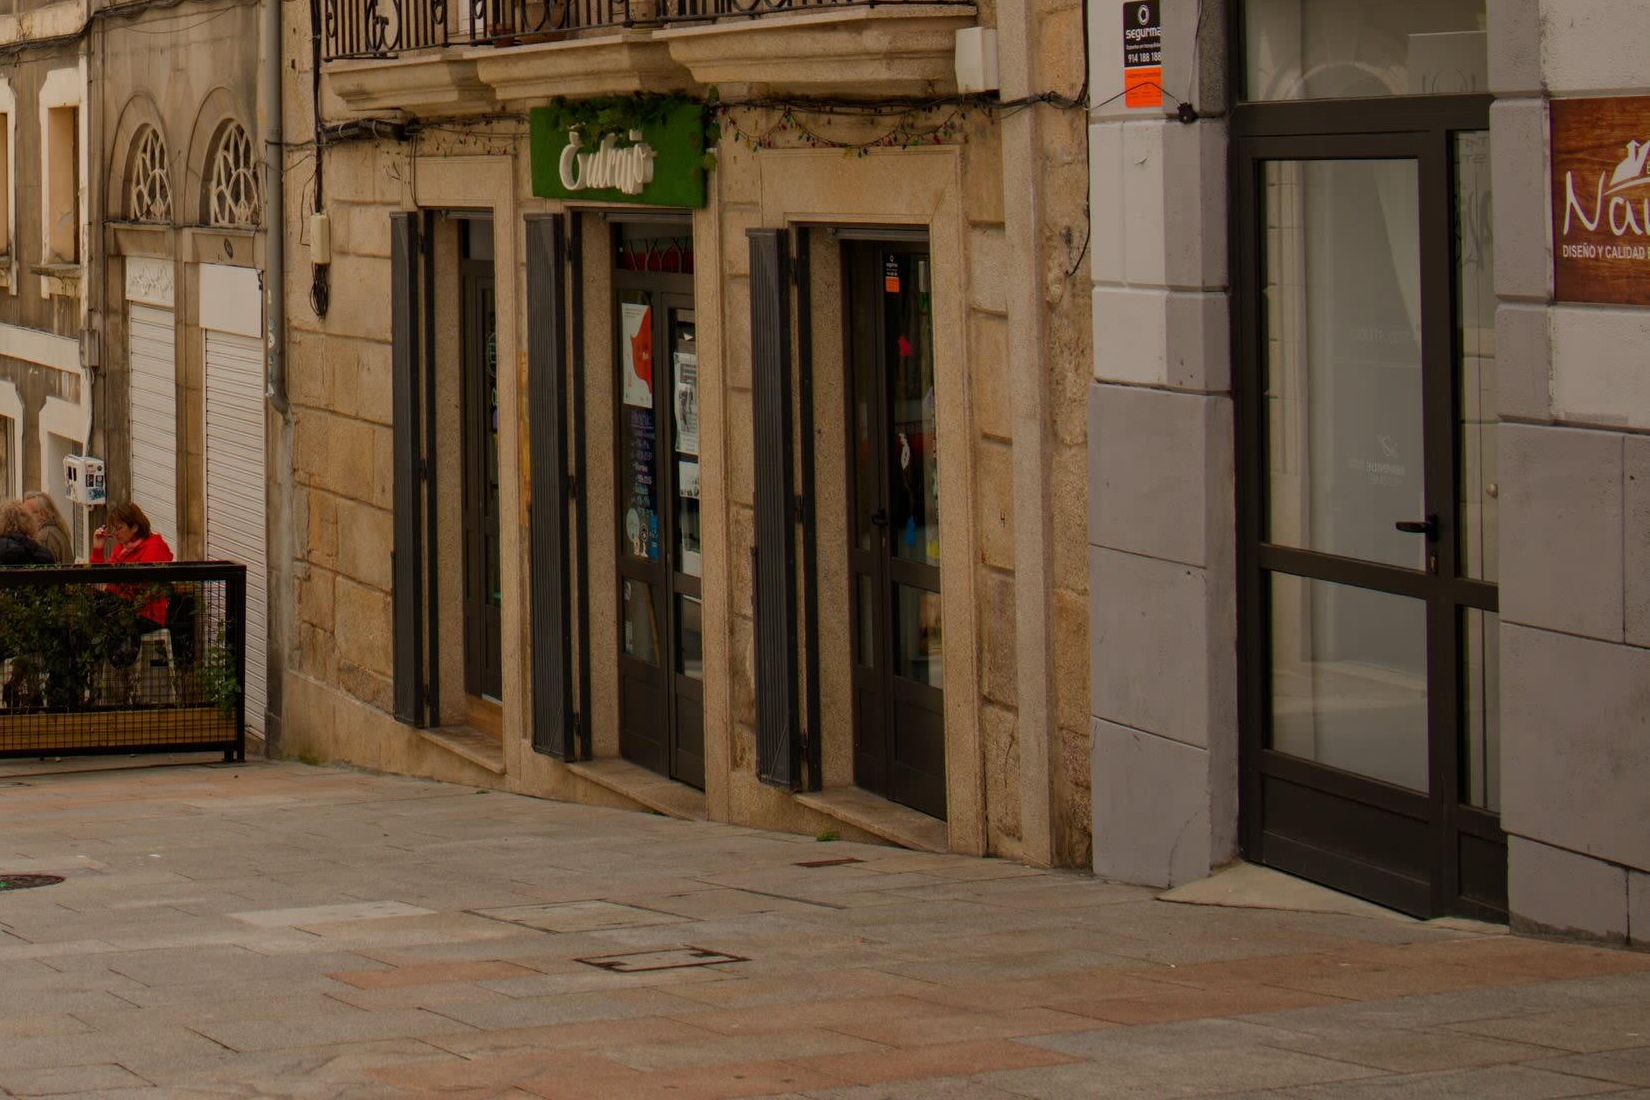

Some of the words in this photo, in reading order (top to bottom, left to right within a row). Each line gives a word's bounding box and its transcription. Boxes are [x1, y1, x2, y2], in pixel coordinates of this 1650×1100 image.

[1128, 53, 1138, 63] 914
[1563, 243, 1596, 258] DISEÑO
[1598, 246, 1604, 258] Y
[1605, 246, 1646, 259] CALIDAD
